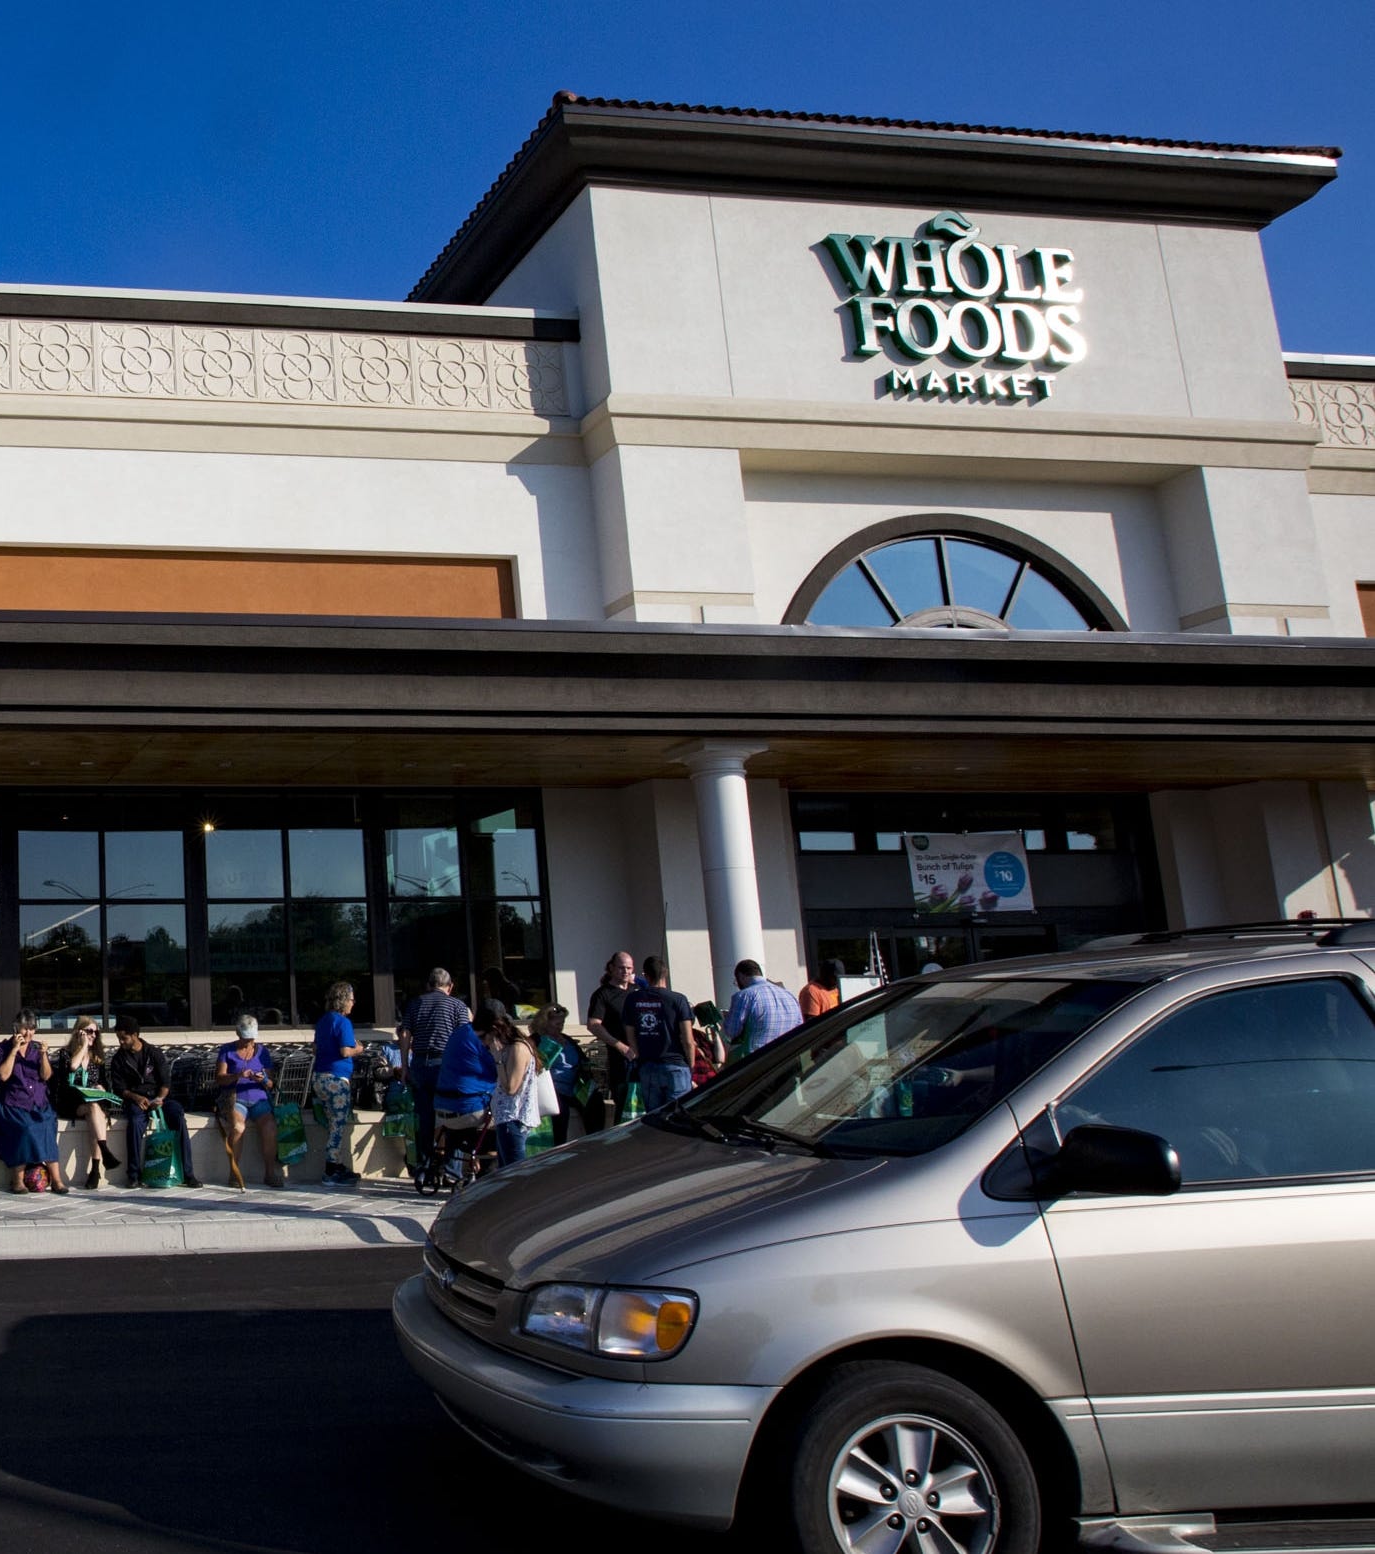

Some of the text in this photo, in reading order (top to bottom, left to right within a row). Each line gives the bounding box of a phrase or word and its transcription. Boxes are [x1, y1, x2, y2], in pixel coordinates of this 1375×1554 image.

[826, 214, 1083, 303] WHOLE
[848, 296, 1088, 364] FOODS
[885, 368, 1057, 399] MARKET
[916, 861, 975, 872] Bunch of Tulips
[994, 869, 1014, 882] $10
[918, 873, 937, 885] $15
